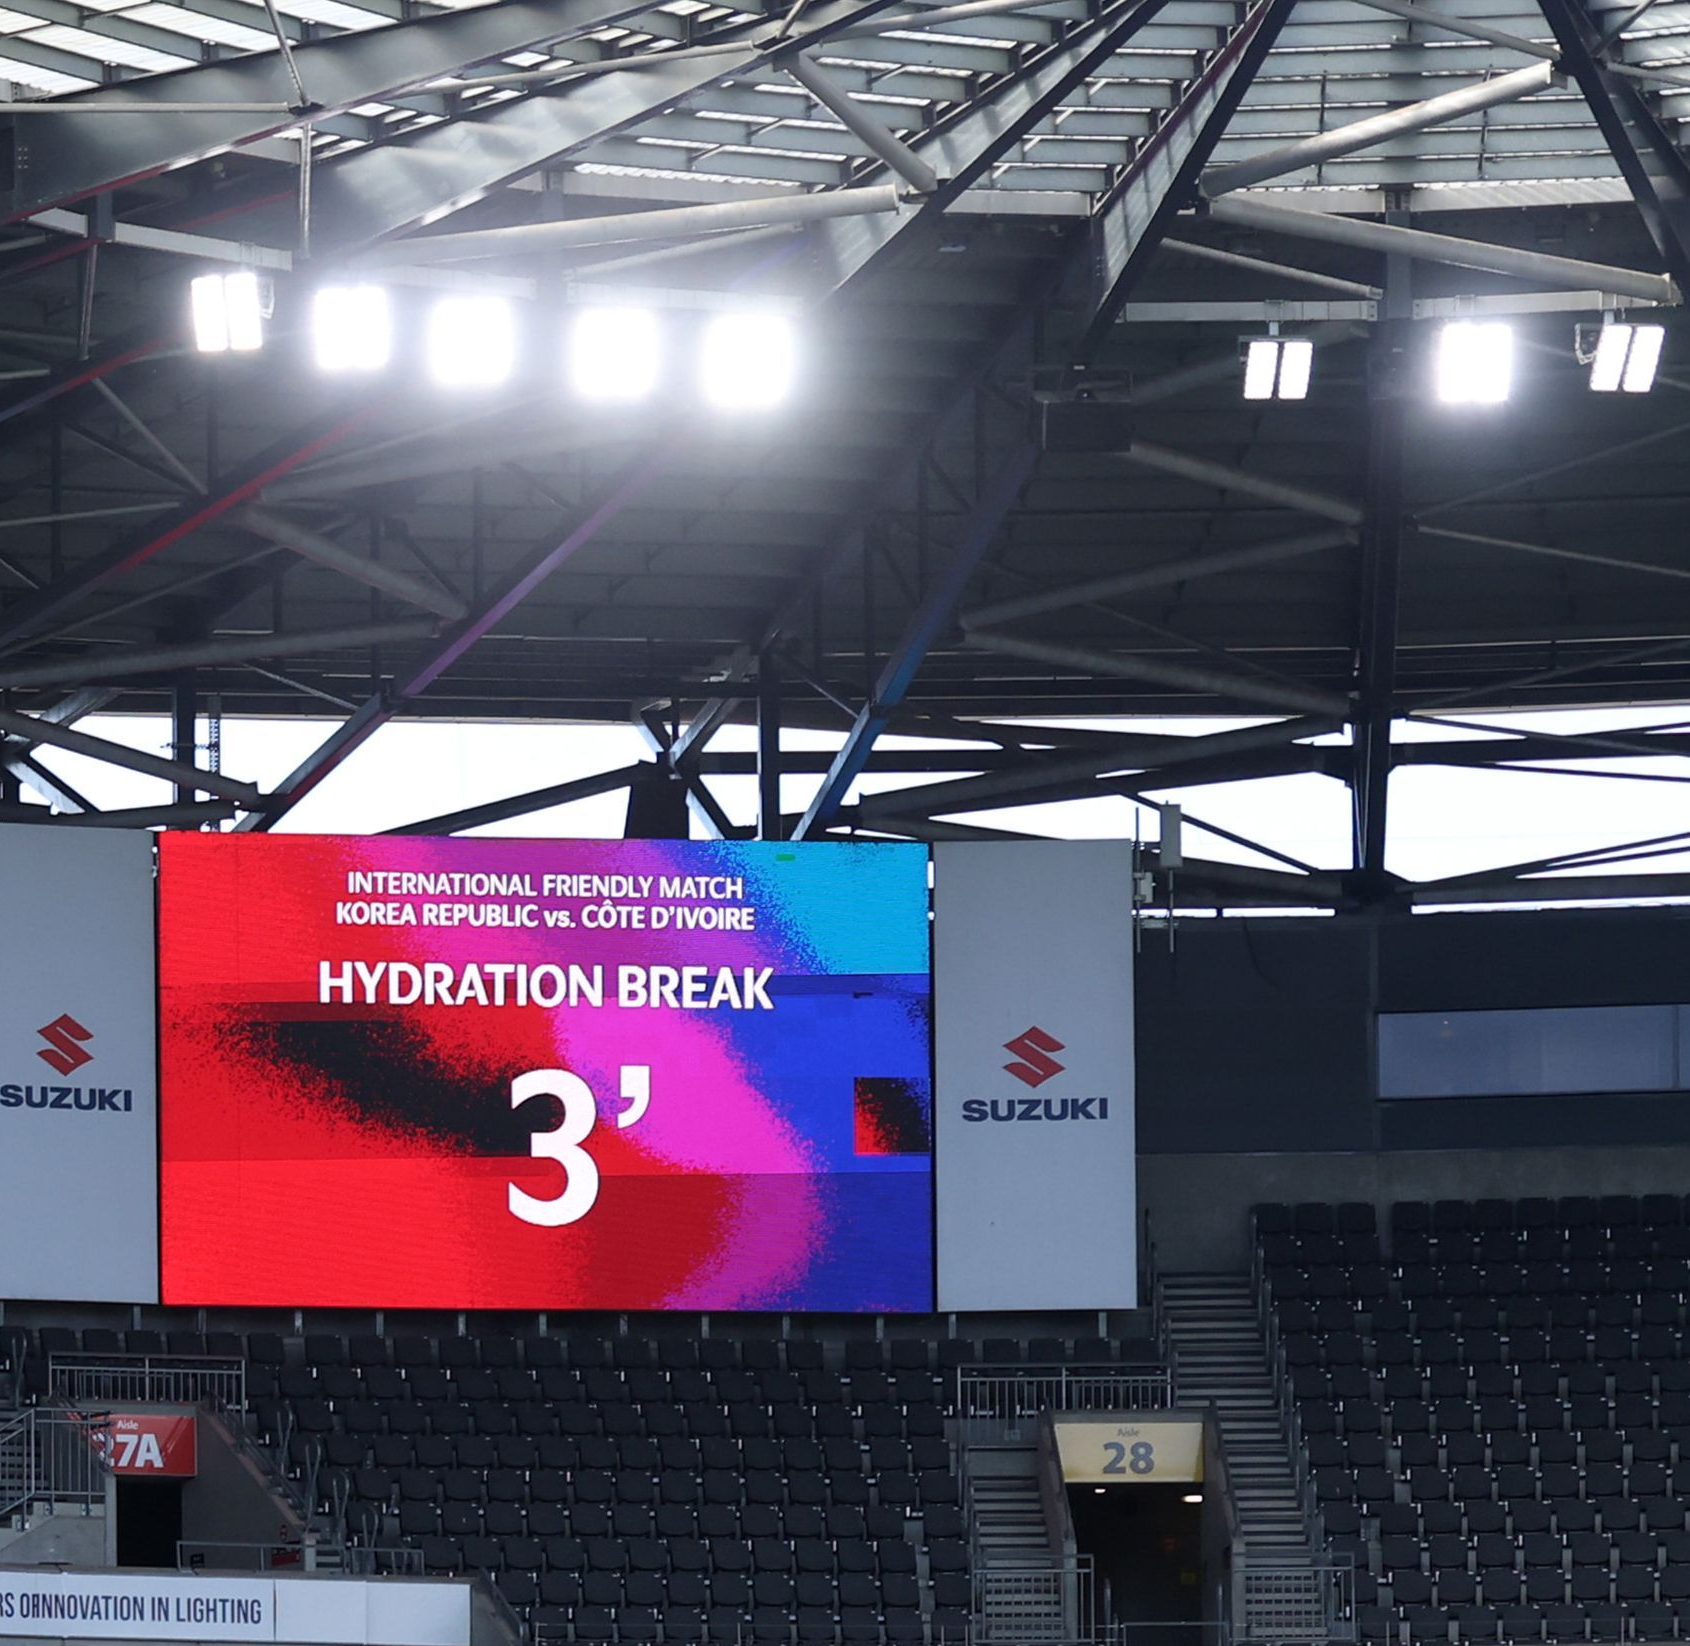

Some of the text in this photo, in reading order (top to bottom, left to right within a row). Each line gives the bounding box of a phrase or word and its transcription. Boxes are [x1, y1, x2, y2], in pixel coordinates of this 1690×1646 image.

[348, 871, 743, 900] INTERNATIONAL FRIENDLY MATCH
[336, 902, 416, 927] KOREA
[423, 903, 539, 928] REPUBLIC
[543, 909, 576, 928] vs.
[581, 899, 645, 930] CÔTE
[318, 960, 774, 1009] HYDRATION BREAK
[0, 1084, 132, 1111] SUZUKI
[962, 1097, 1108, 1122] SUZUKI
[117, 1420, 139, 1430] Aisle
[1116, 1428, 1140, 1437] Aisle
[1102, 1441, 1155, 1475] 28
[150, 1596, 170, 1622] IN
[175, 1597, 262, 1624] LIGHTING
